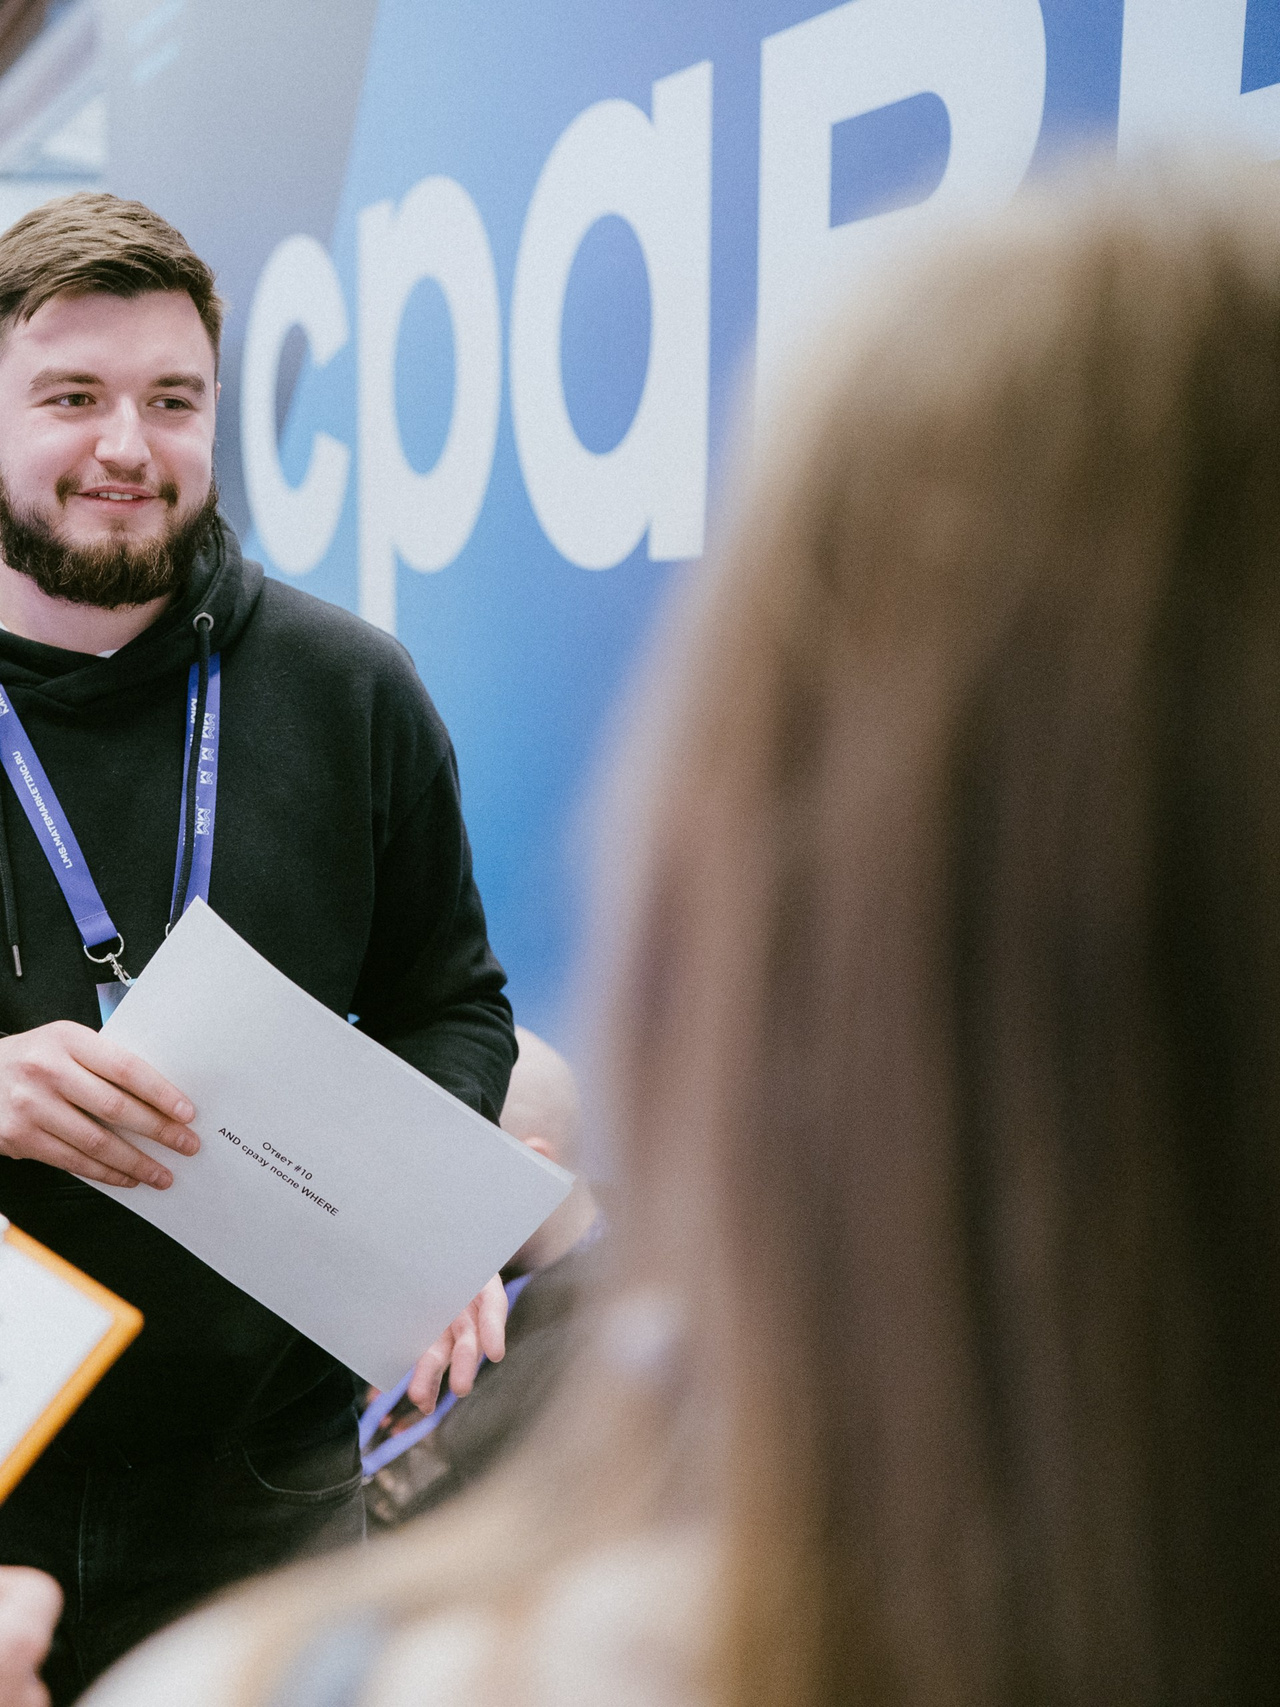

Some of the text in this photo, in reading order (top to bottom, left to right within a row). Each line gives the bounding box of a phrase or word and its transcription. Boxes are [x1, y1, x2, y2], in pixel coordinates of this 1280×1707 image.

[12, 750, 73, 869] LMS.MATEMARKETING.RU
[218, 1127, 340, 1217] AND сразу после WHERE
[262, 1141, 313, 1181] Ответ #10
